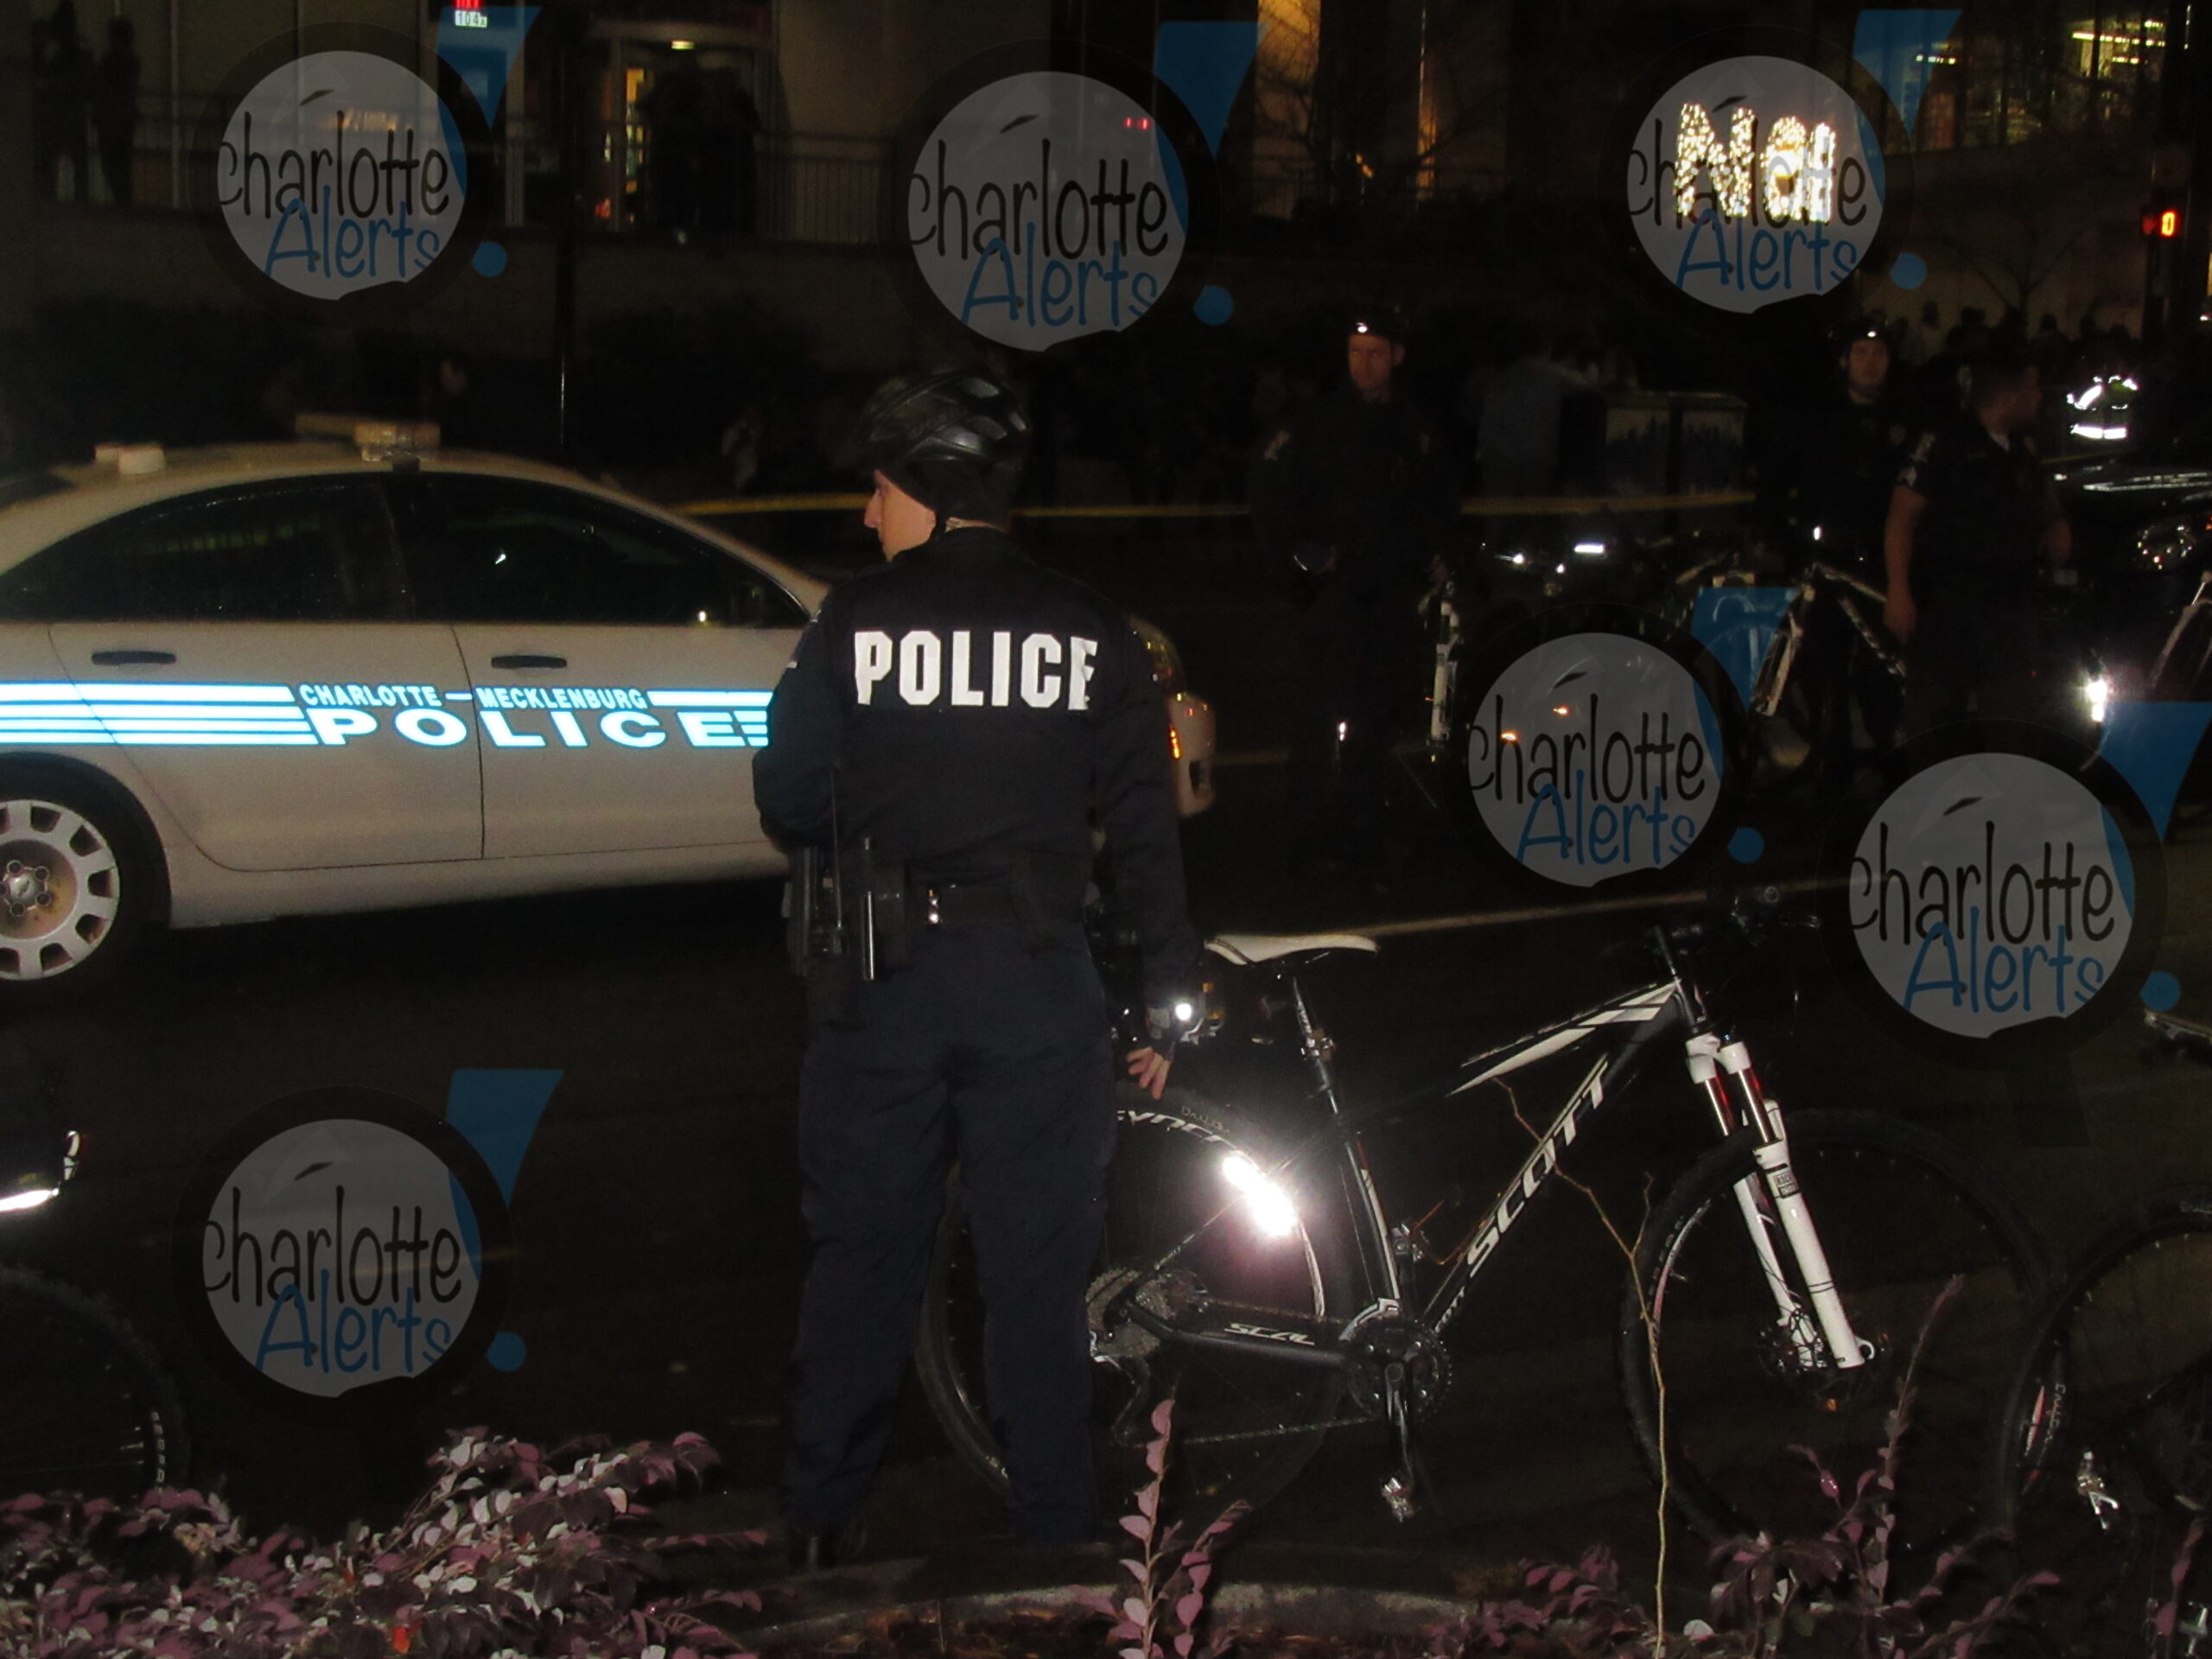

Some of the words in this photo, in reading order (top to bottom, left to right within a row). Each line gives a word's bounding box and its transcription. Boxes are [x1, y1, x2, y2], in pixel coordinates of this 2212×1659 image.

[299, 683, 442, 707] CHARLOTTE
[475, 687, 648, 709] MECKLENBURG
[854, 630, 1099, 711] POLICE
[305, 708, 747, 747] POLICE
[1467, 1061, 1609, 1278] SCOTT
